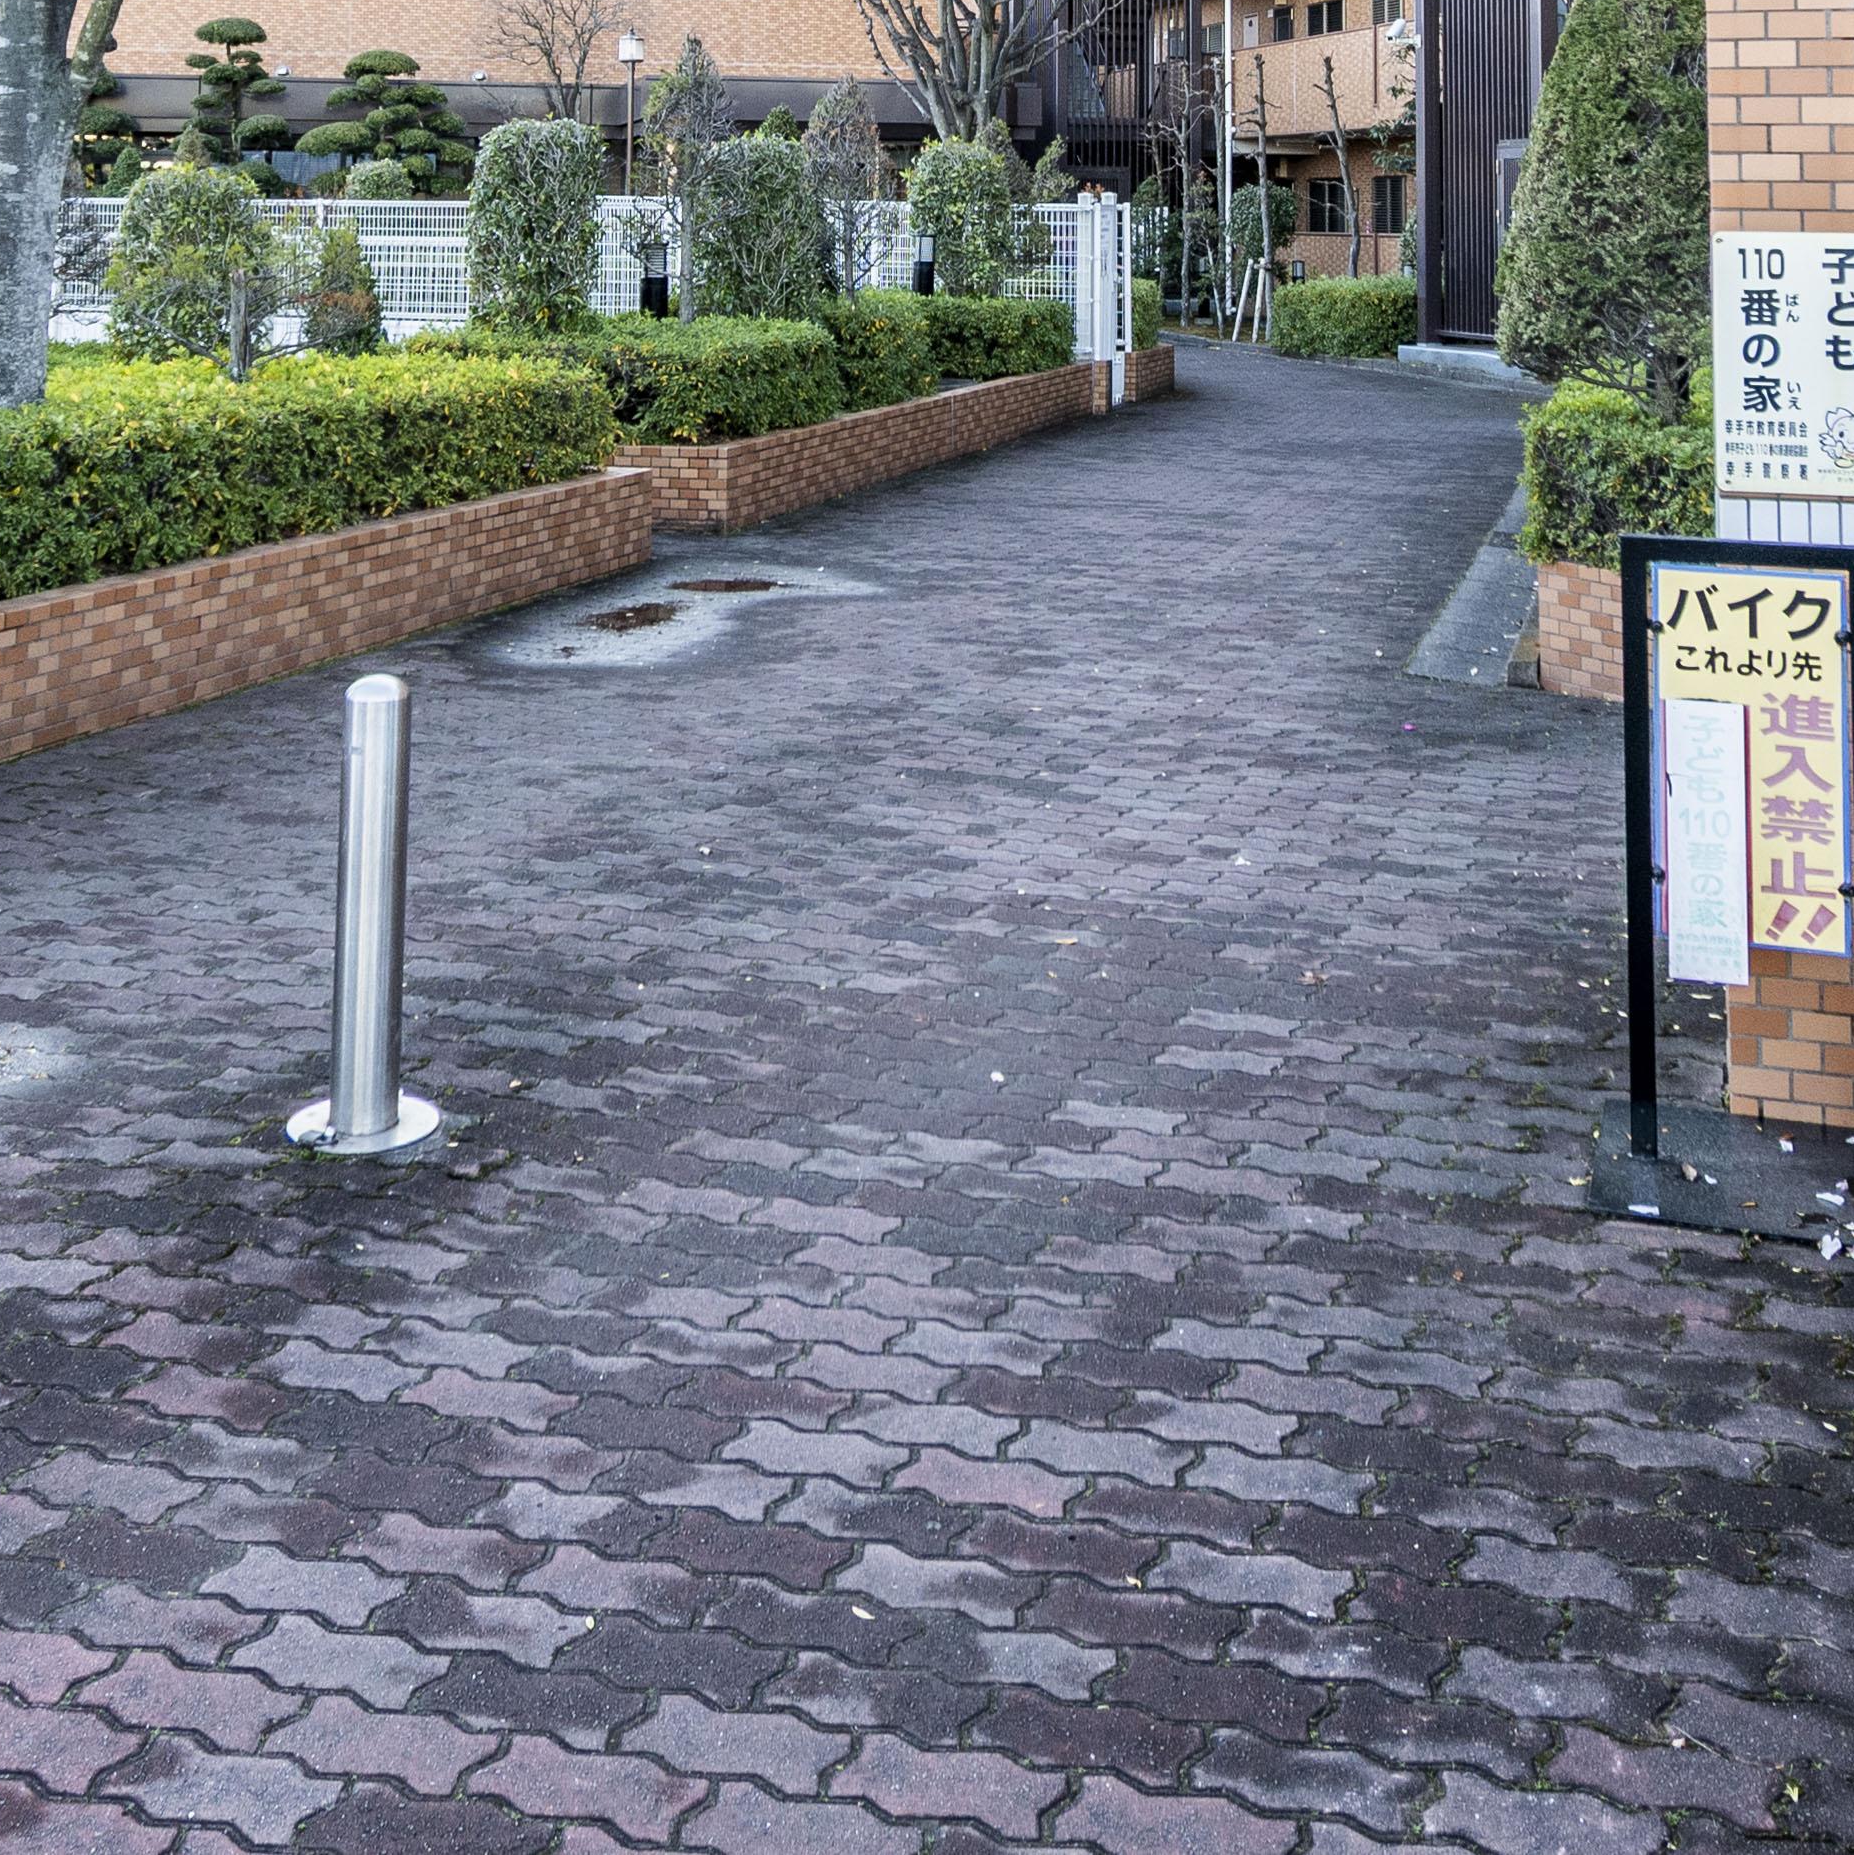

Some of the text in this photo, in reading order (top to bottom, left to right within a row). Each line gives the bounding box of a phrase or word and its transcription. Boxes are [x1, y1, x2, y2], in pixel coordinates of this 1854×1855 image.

[1785, 293, 1800, 323] ばん
[1738, 248, 1785, 413] 110番の家
[1787, 381, 1802, 411] いえ
[1725, 419, 1808, 438] 幸手市教育委員会
[1665, 585, 1832, 642] バイク
[1673, 643, 1823, 684] これより先
